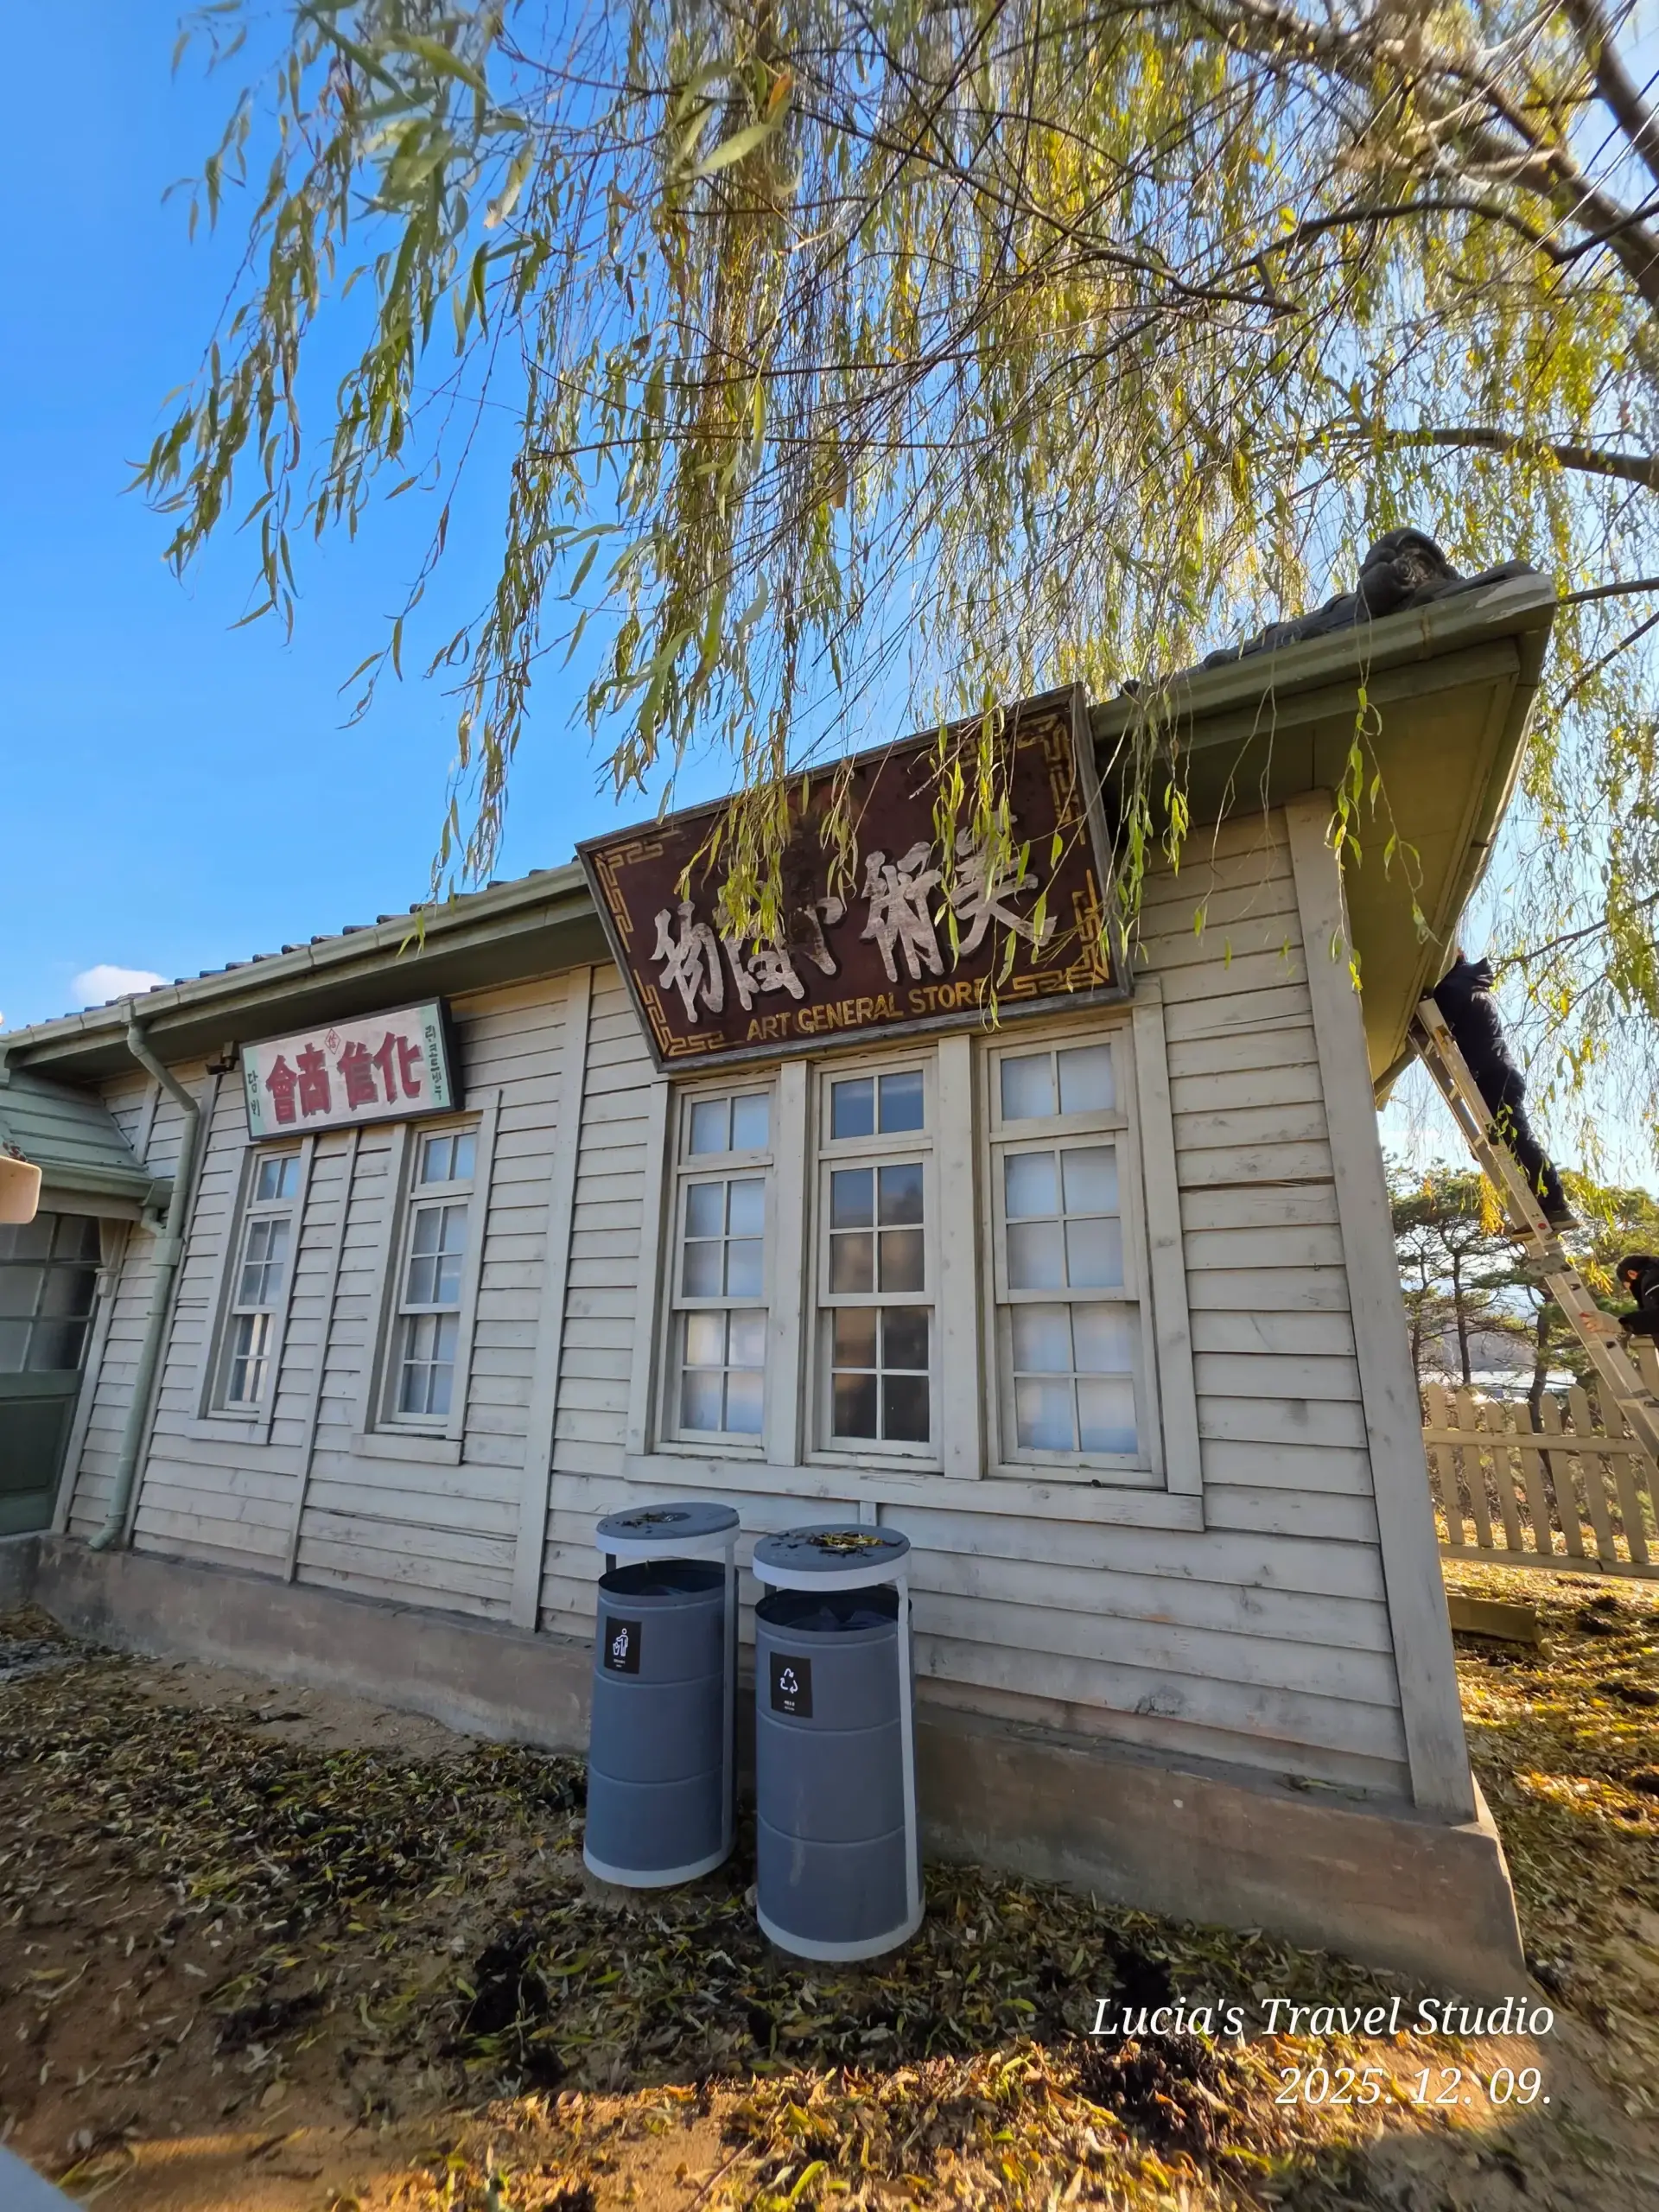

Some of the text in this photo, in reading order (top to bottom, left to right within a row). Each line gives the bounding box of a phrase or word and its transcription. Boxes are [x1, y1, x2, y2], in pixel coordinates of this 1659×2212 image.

[747, 977, 989, 1041] ART GENERAL STORE
